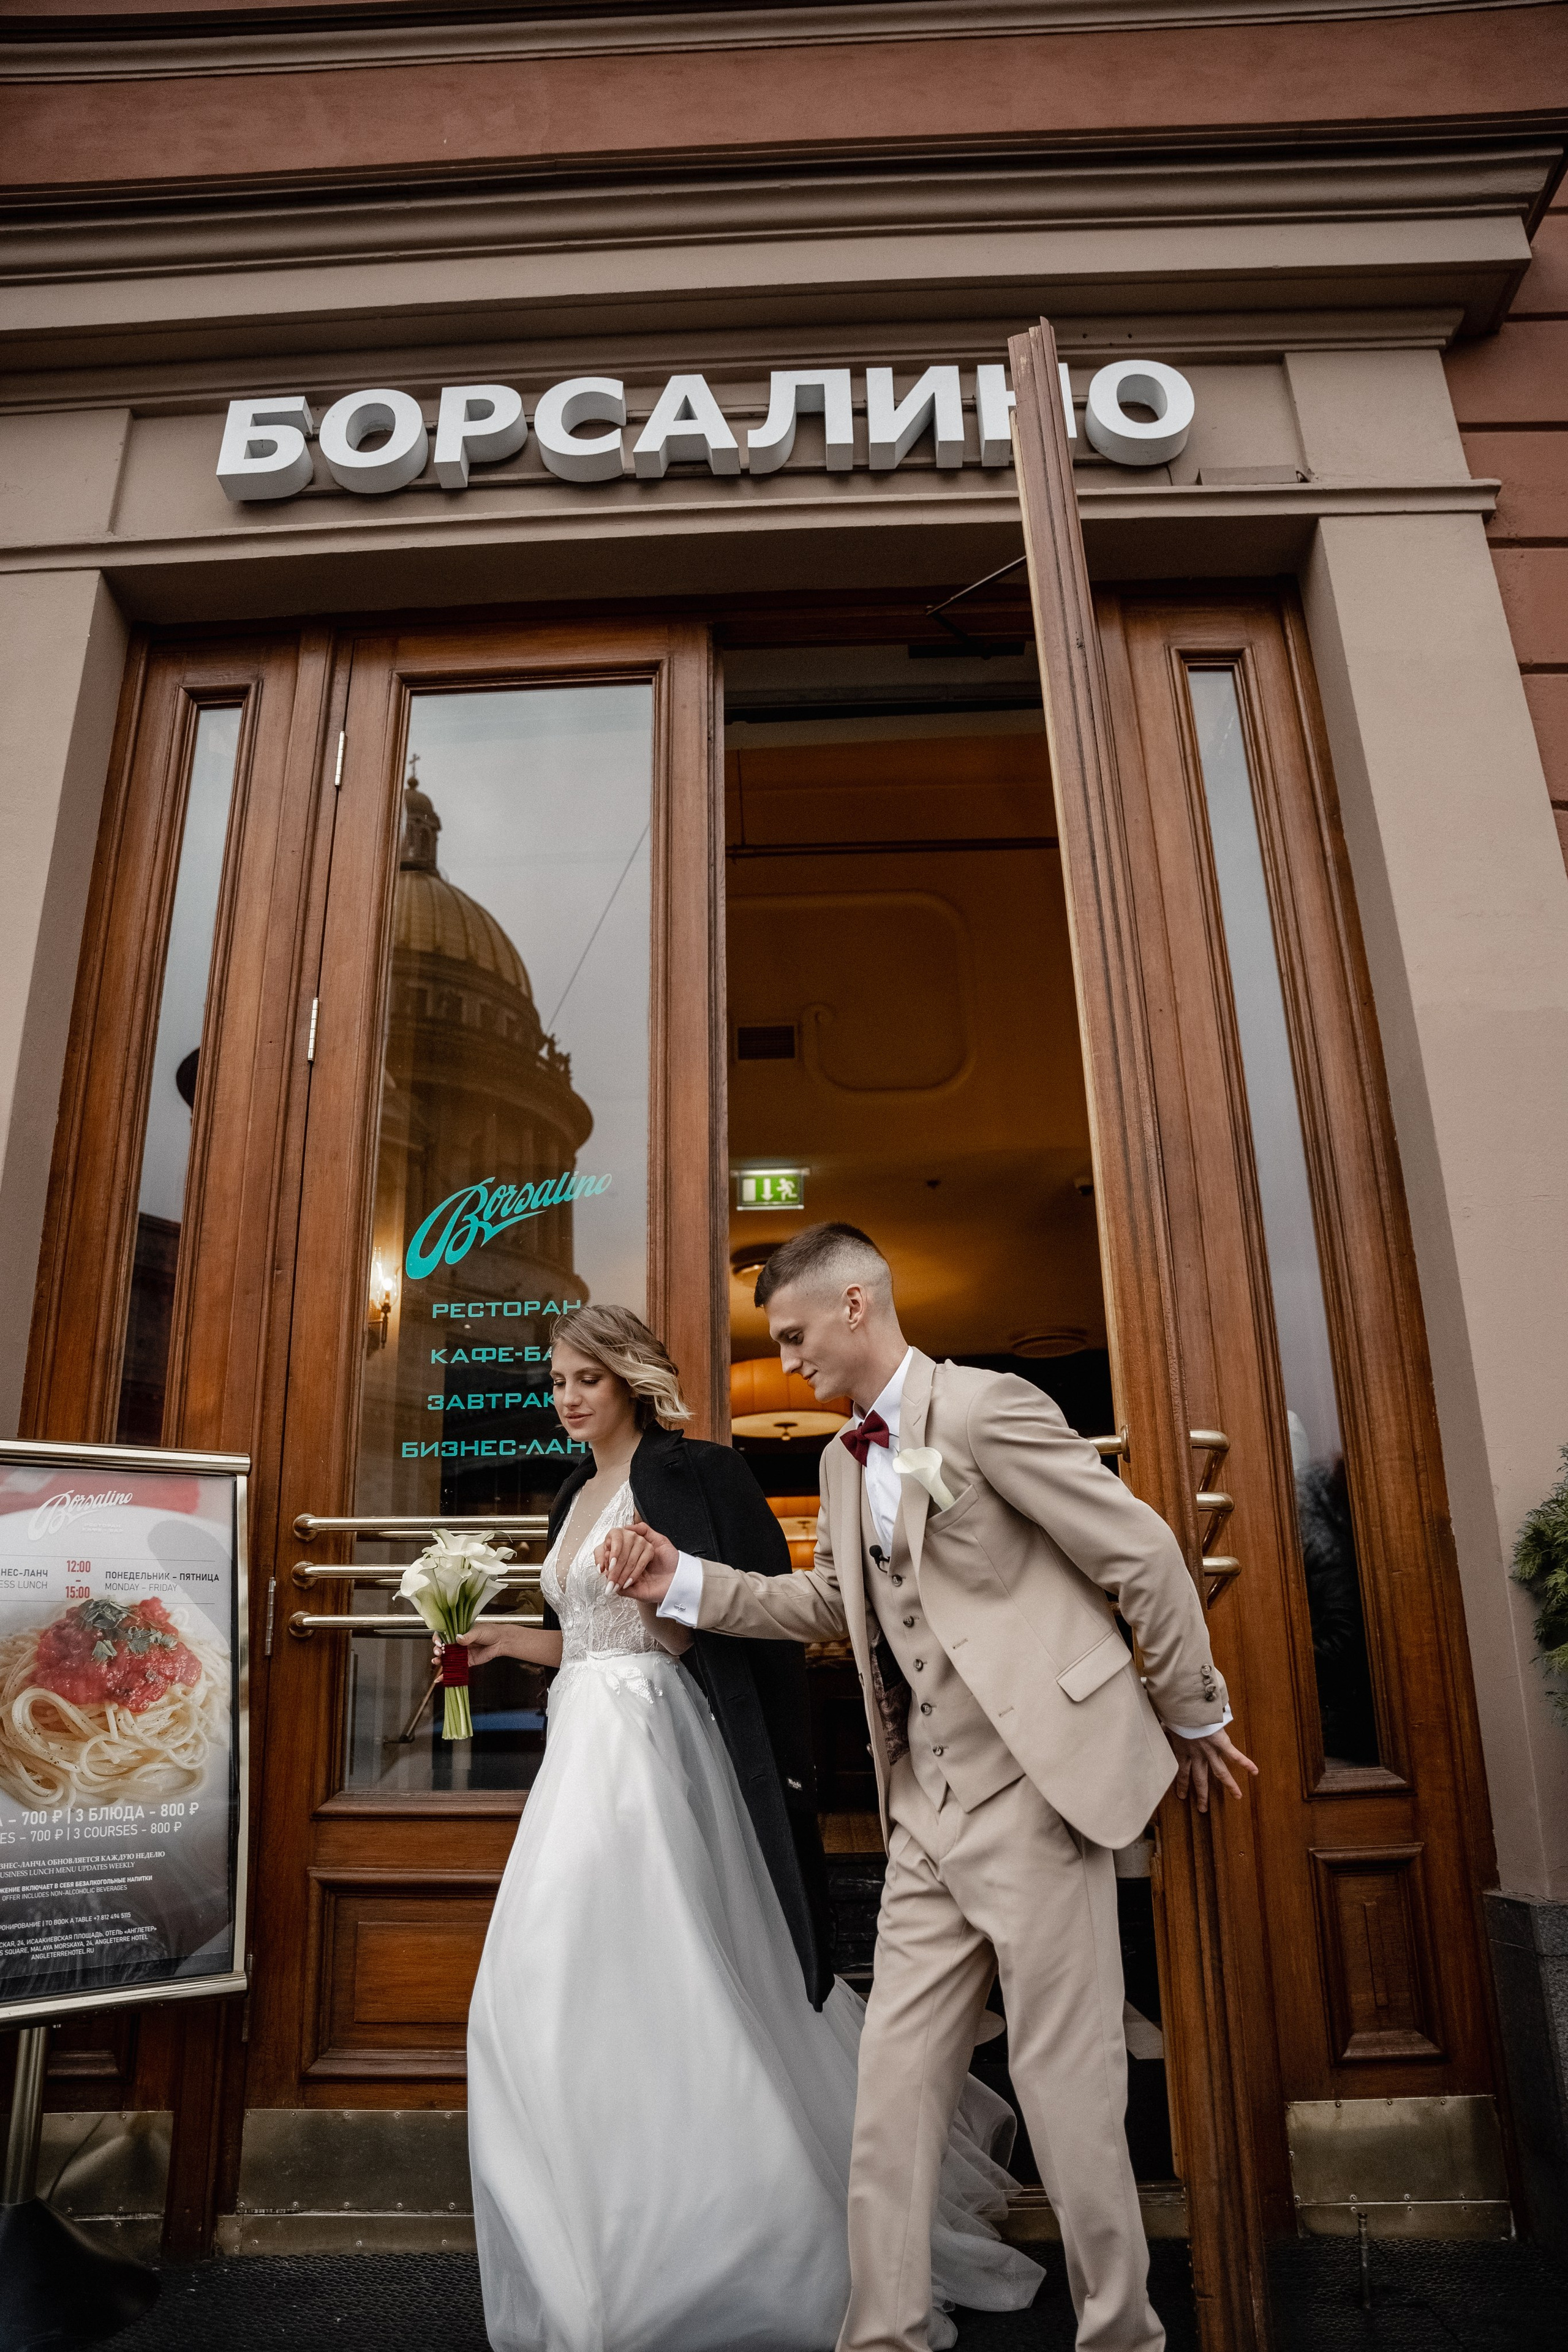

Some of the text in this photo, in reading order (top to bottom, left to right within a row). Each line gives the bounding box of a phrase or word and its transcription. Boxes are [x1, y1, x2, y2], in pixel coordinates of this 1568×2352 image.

[216, 360, 1195, 500] БОРСАЛИНО
[405, 1170, 612, 1280] Borsalino
[432, 1300, 581, 1318] РЕСТОРАН
[402, 1439, 592, 1457] БИЗНЕС-ЛАН
[28, 1490, 133, 1540] Borsalino
[67, 1560, 91, 1572] 12:00
[105, 1571, 170, 1580] ПОНЕДЕЛЬНИК
[179, 1573, 220, 1582] ПЯТНИЦА
[18, 1580, 48, 1589] LUNCH
[105, 1583, 140, 1591] MONDAY
[66, 1586, 90, 1599] 15:00
[22, 1811, 47, 1825] 700
[75, 1808, 83, 1822] 3
[88, 1805, 145, 1822] БЛЮДА
[160, 1803, 185, 1817] 800
[31, 1830, 51, 1842] 700
[74, 1828, 80, 1839] 3
[84, 1824, 138, 1838] COURSES
[151, 1822, 170, 1834] 800
[47, 1856, 100, 1866] ОБНОВЛЯЕТСЯ
[100, 1853, 134, 1861] КАЖДУЮ
[135, 1850, 165, 1860] НЕДЕЛЮ
[29, 1868, 55, 1876] LUNCH
[56, 1865, 77, 1874] MENU
[78, 1863, 108, 1872] UPDATES
[75, 1877, 126, 1887] БЕЗАЛКОГОЛЬНЫЕ
[50, 1887, 96, 1897] NON-ALCOHOLIC
[26, 1934, 72, 1945] ИСААКИЕВСКАЯ
[124, 1926, 157, 1934] «АНГЛЕТЕР»
[95, 1936, 130, 1945] ANGLETERRE
[31, 1948, 94, 1960] ANGLETERREHOTEL.RU
